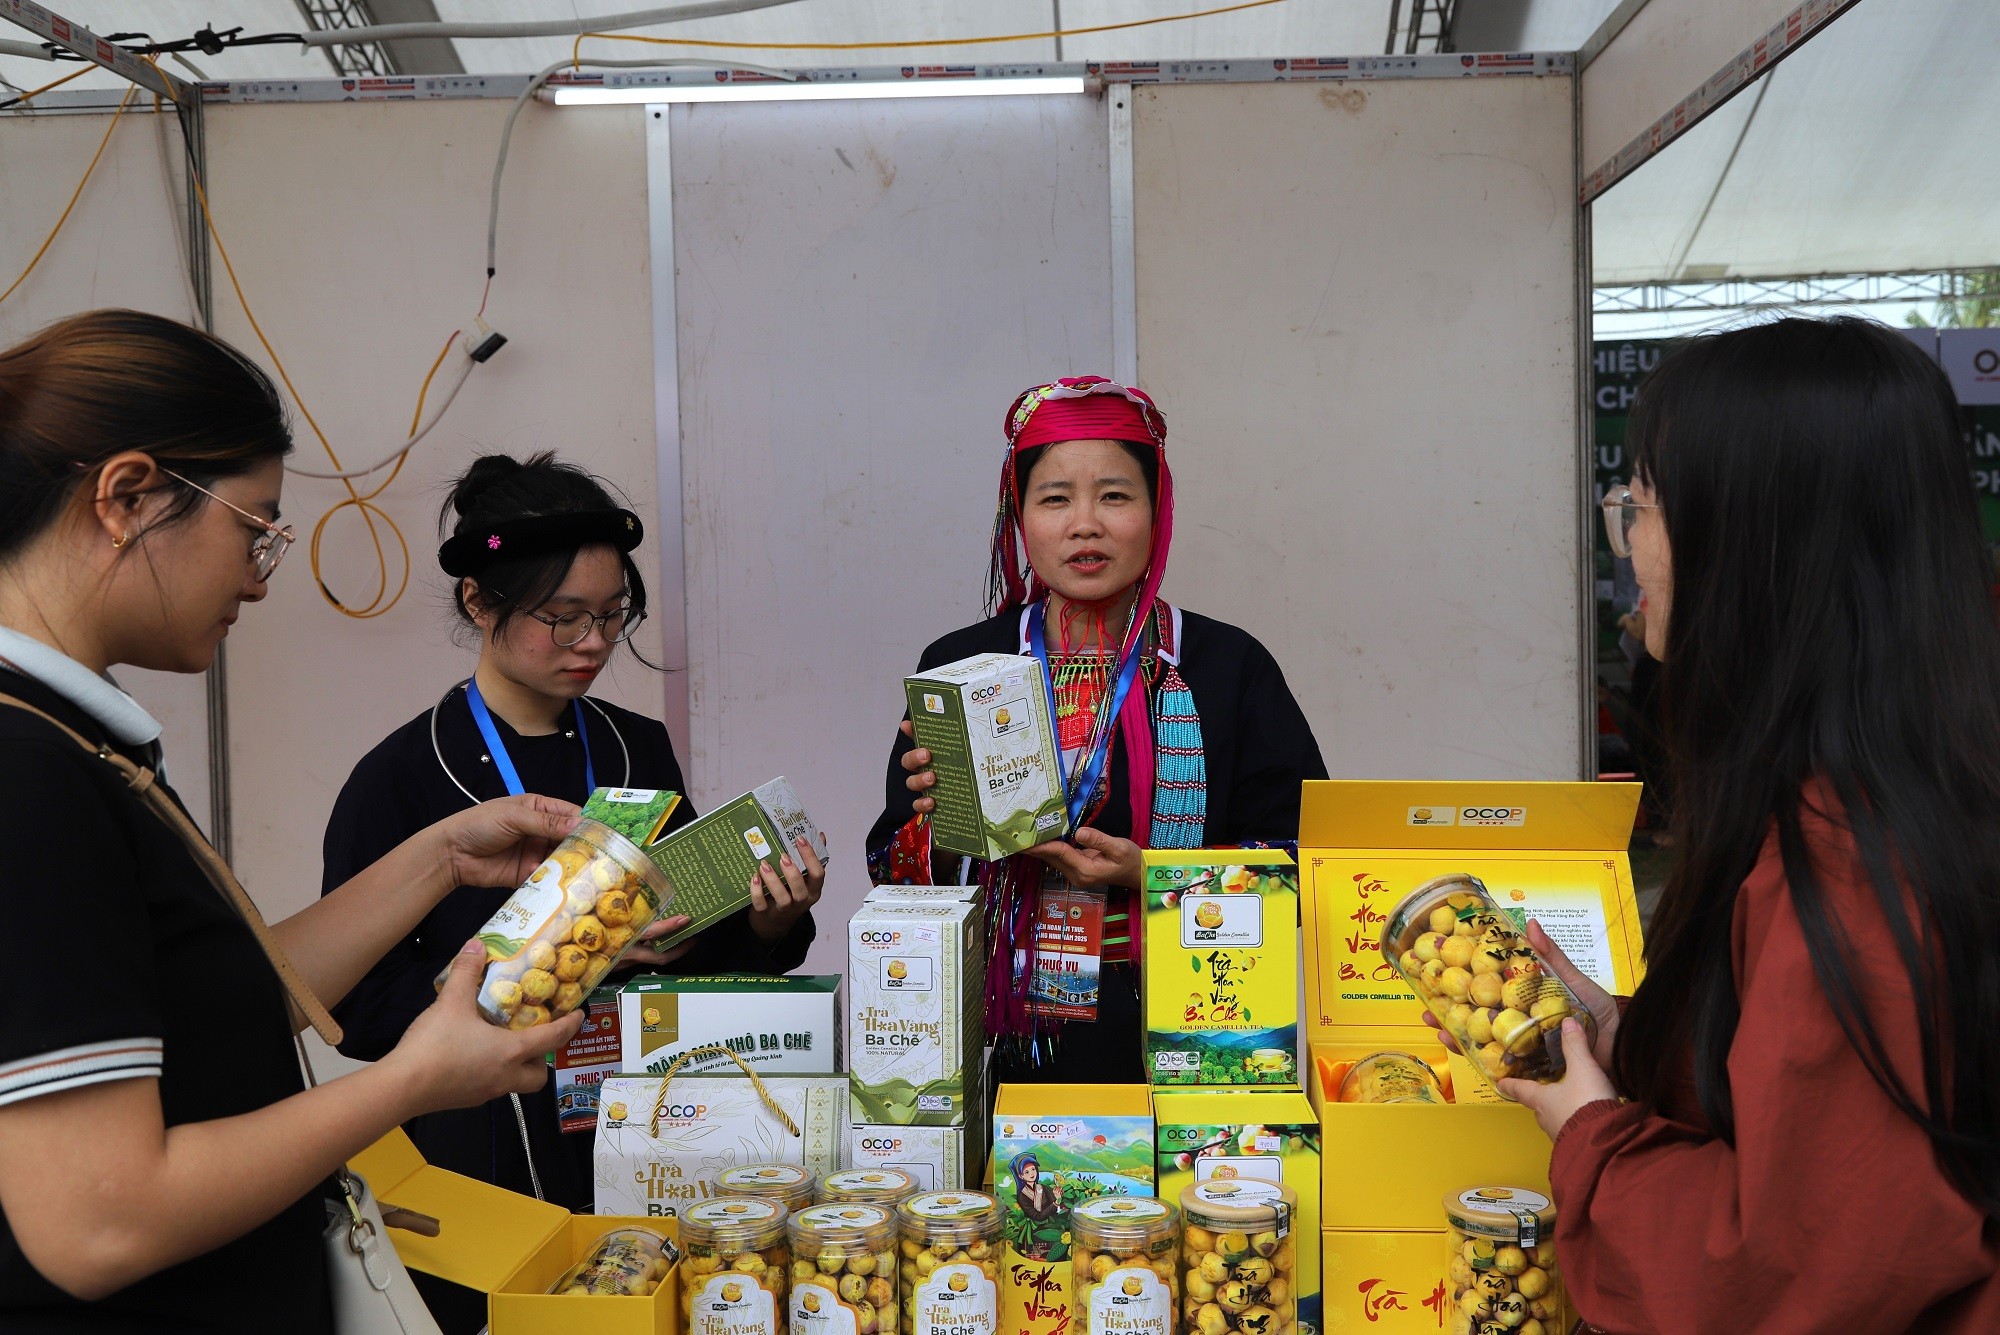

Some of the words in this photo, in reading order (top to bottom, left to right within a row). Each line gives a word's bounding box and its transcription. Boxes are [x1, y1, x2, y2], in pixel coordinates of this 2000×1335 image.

[971, 684, 1002, 701] OCOP
[989, 779, 1004, 790] Ba
[1007, 766, 1029, 783] Chẽ
[1463, 808, 1522, 818] OCOP
[1155, 870, 1191, 879] OCOP
[861, 932, 901, 943] OCOP
[1066, 960, 1079, 975] VỤ
[1207, 950, 1238, 978] Trà
[1338, 962, 1365, 981] Ba
[1184, 1005, 1205, 1023] Ba
[581, 1035, 595, 1045] HOAN
[725, 1032, 755, 1052] KHÔ
[760, 1033, 779, 1050] BA
[784, 1031, 812, 1050] CHẼ
[865, 1034, 884, 1045] Ba
[890, 1031, 920, 1046] Chẽ
[608, 1043, 620, 1051] 2025
[575, 1072, 600, 1087] PHỤC
[658, 1105, 707, 1118] OCOP
[1167, 1129, 1206, 1140] OCOP
[862, 1138, 902, 1149] OCOP
[648, 1162, 683, 1178] Trà
[648, 1203, 677, 1217] Ba
[1011, 1264, 1036, 1286] Trà
[1029, 1264, 1062, 1304] Hoa
[1358, 1278, 1408, 1322] Trà
